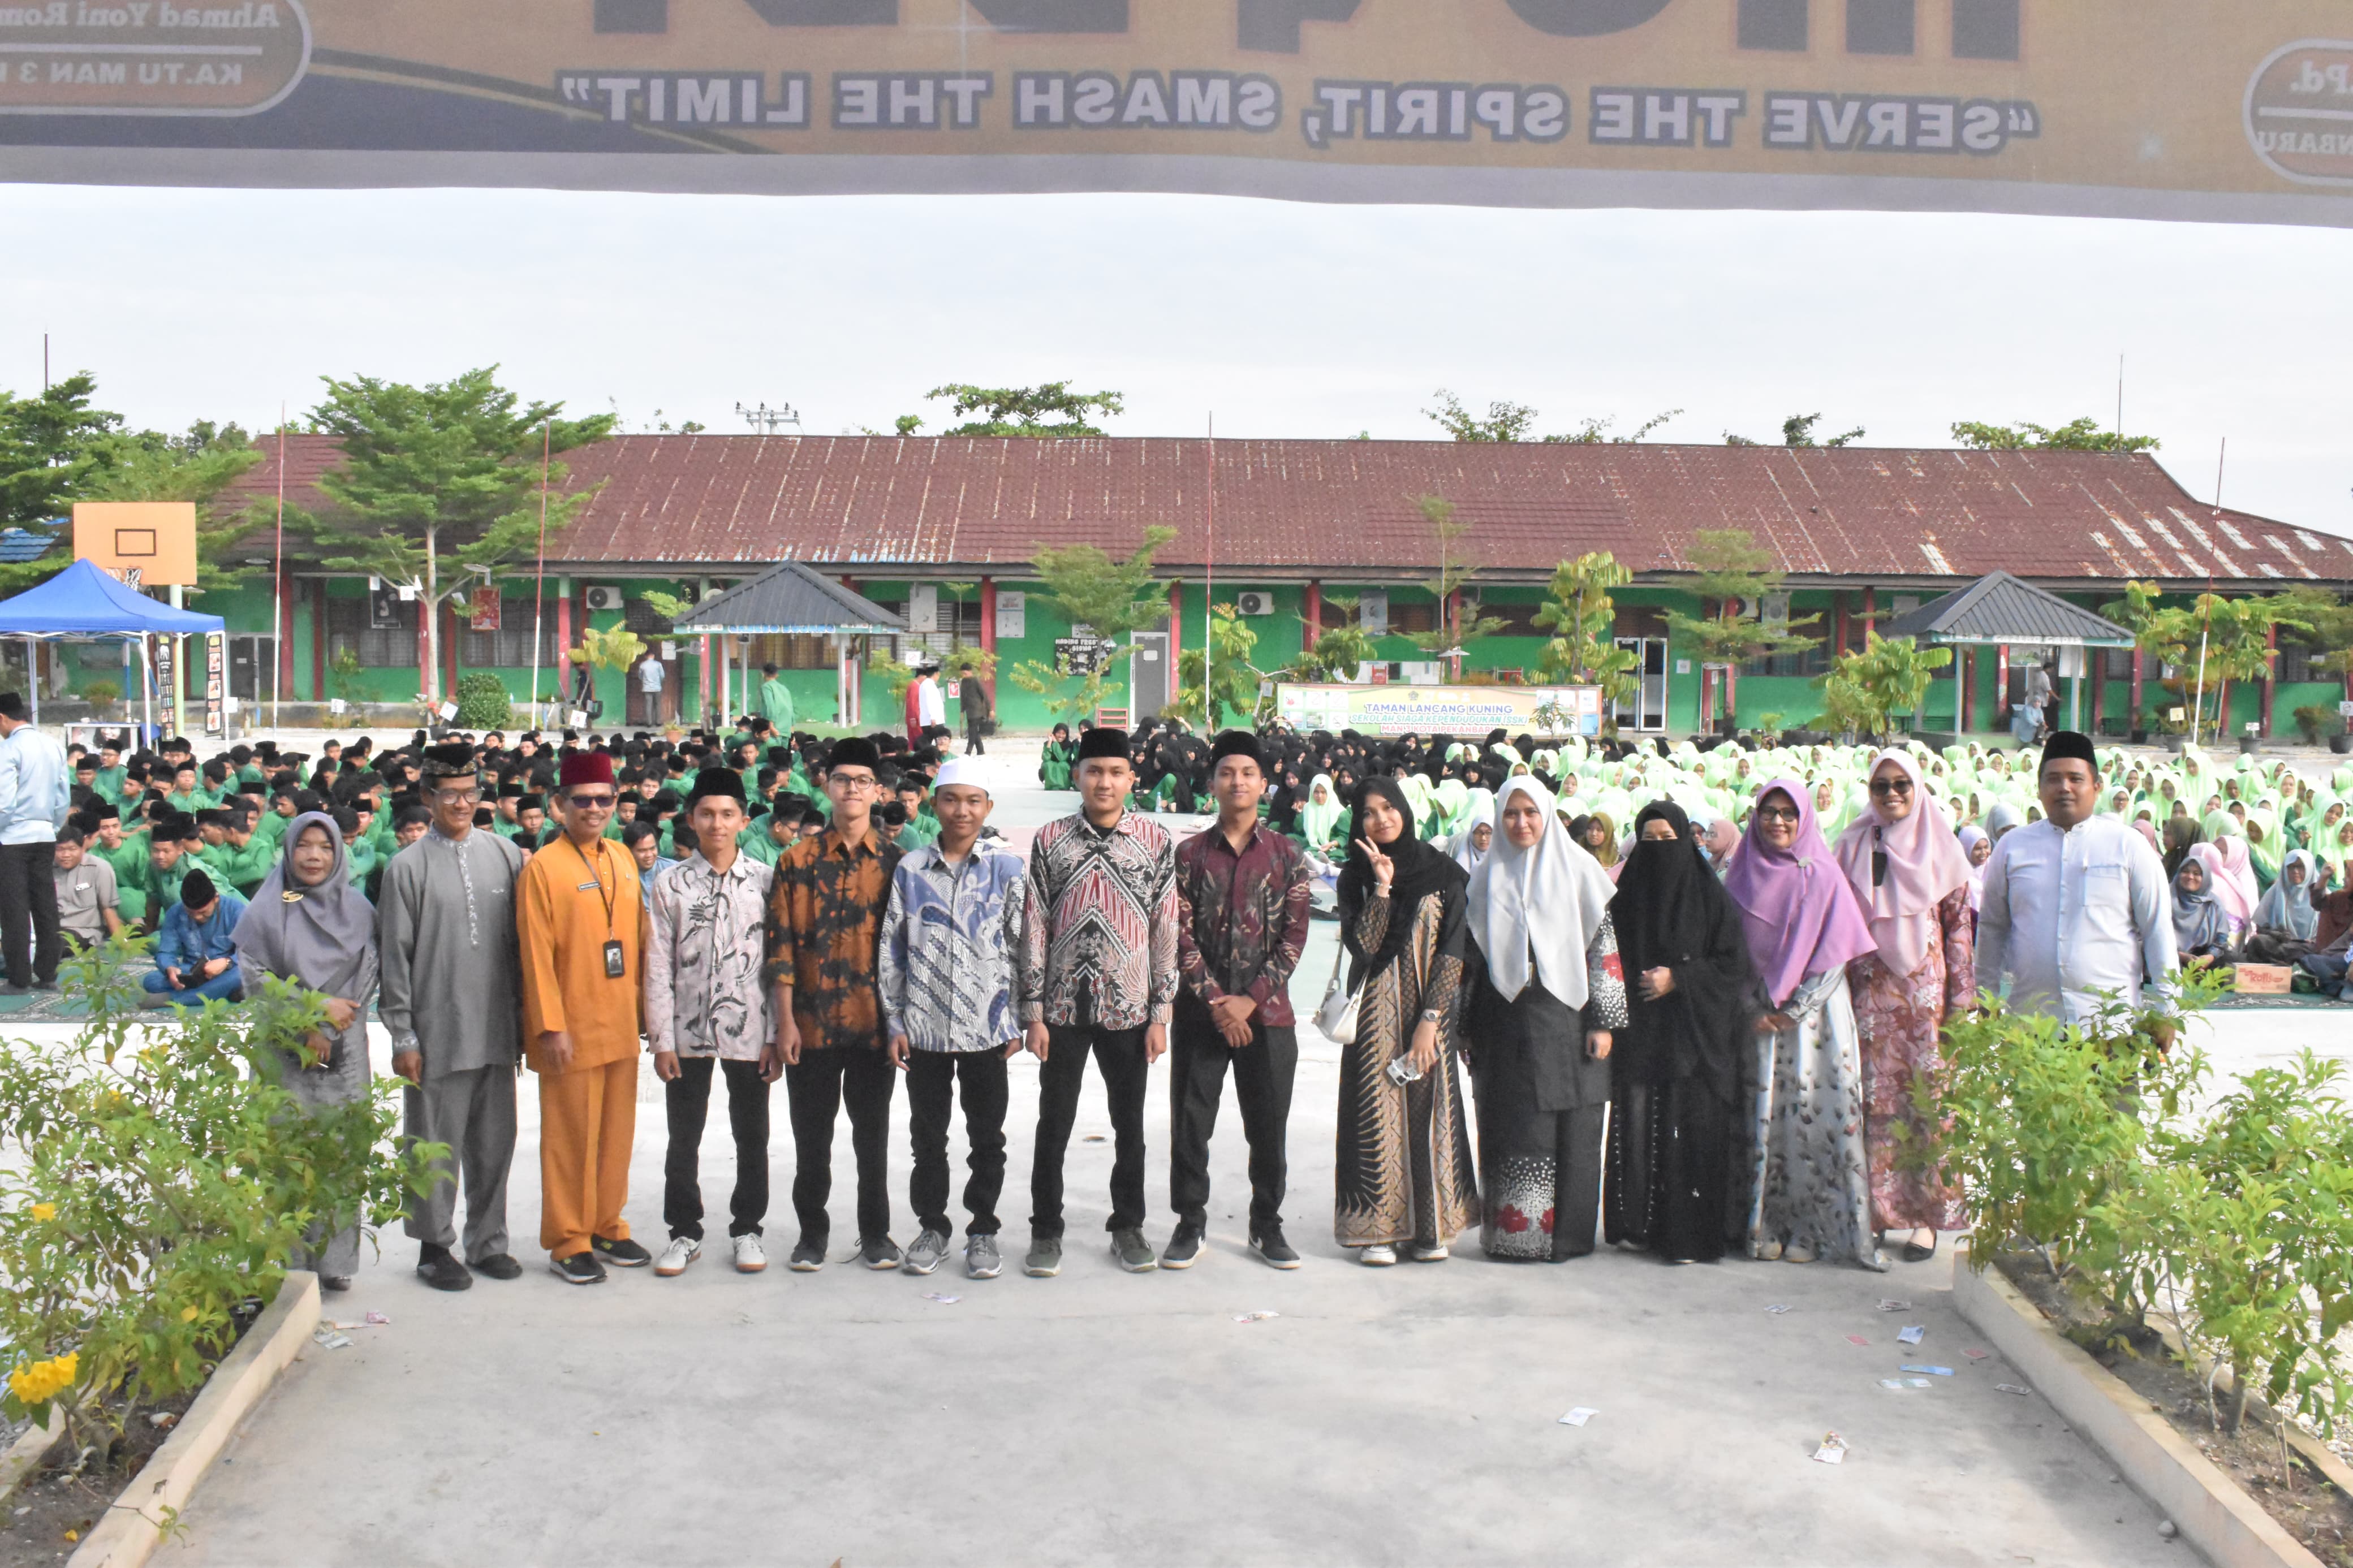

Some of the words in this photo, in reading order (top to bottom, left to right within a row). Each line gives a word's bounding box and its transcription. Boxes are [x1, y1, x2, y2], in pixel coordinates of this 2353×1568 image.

[1366, 704, 1406, 712] TAMAN
[1410, 705, 1466, 713] LANCANG
[1469, 705, 1512, 714] KUNING
[1425, 715, 1501, 724] KEPENDUDUKAN
[1503, 715, 1528, 724] (SSK)
